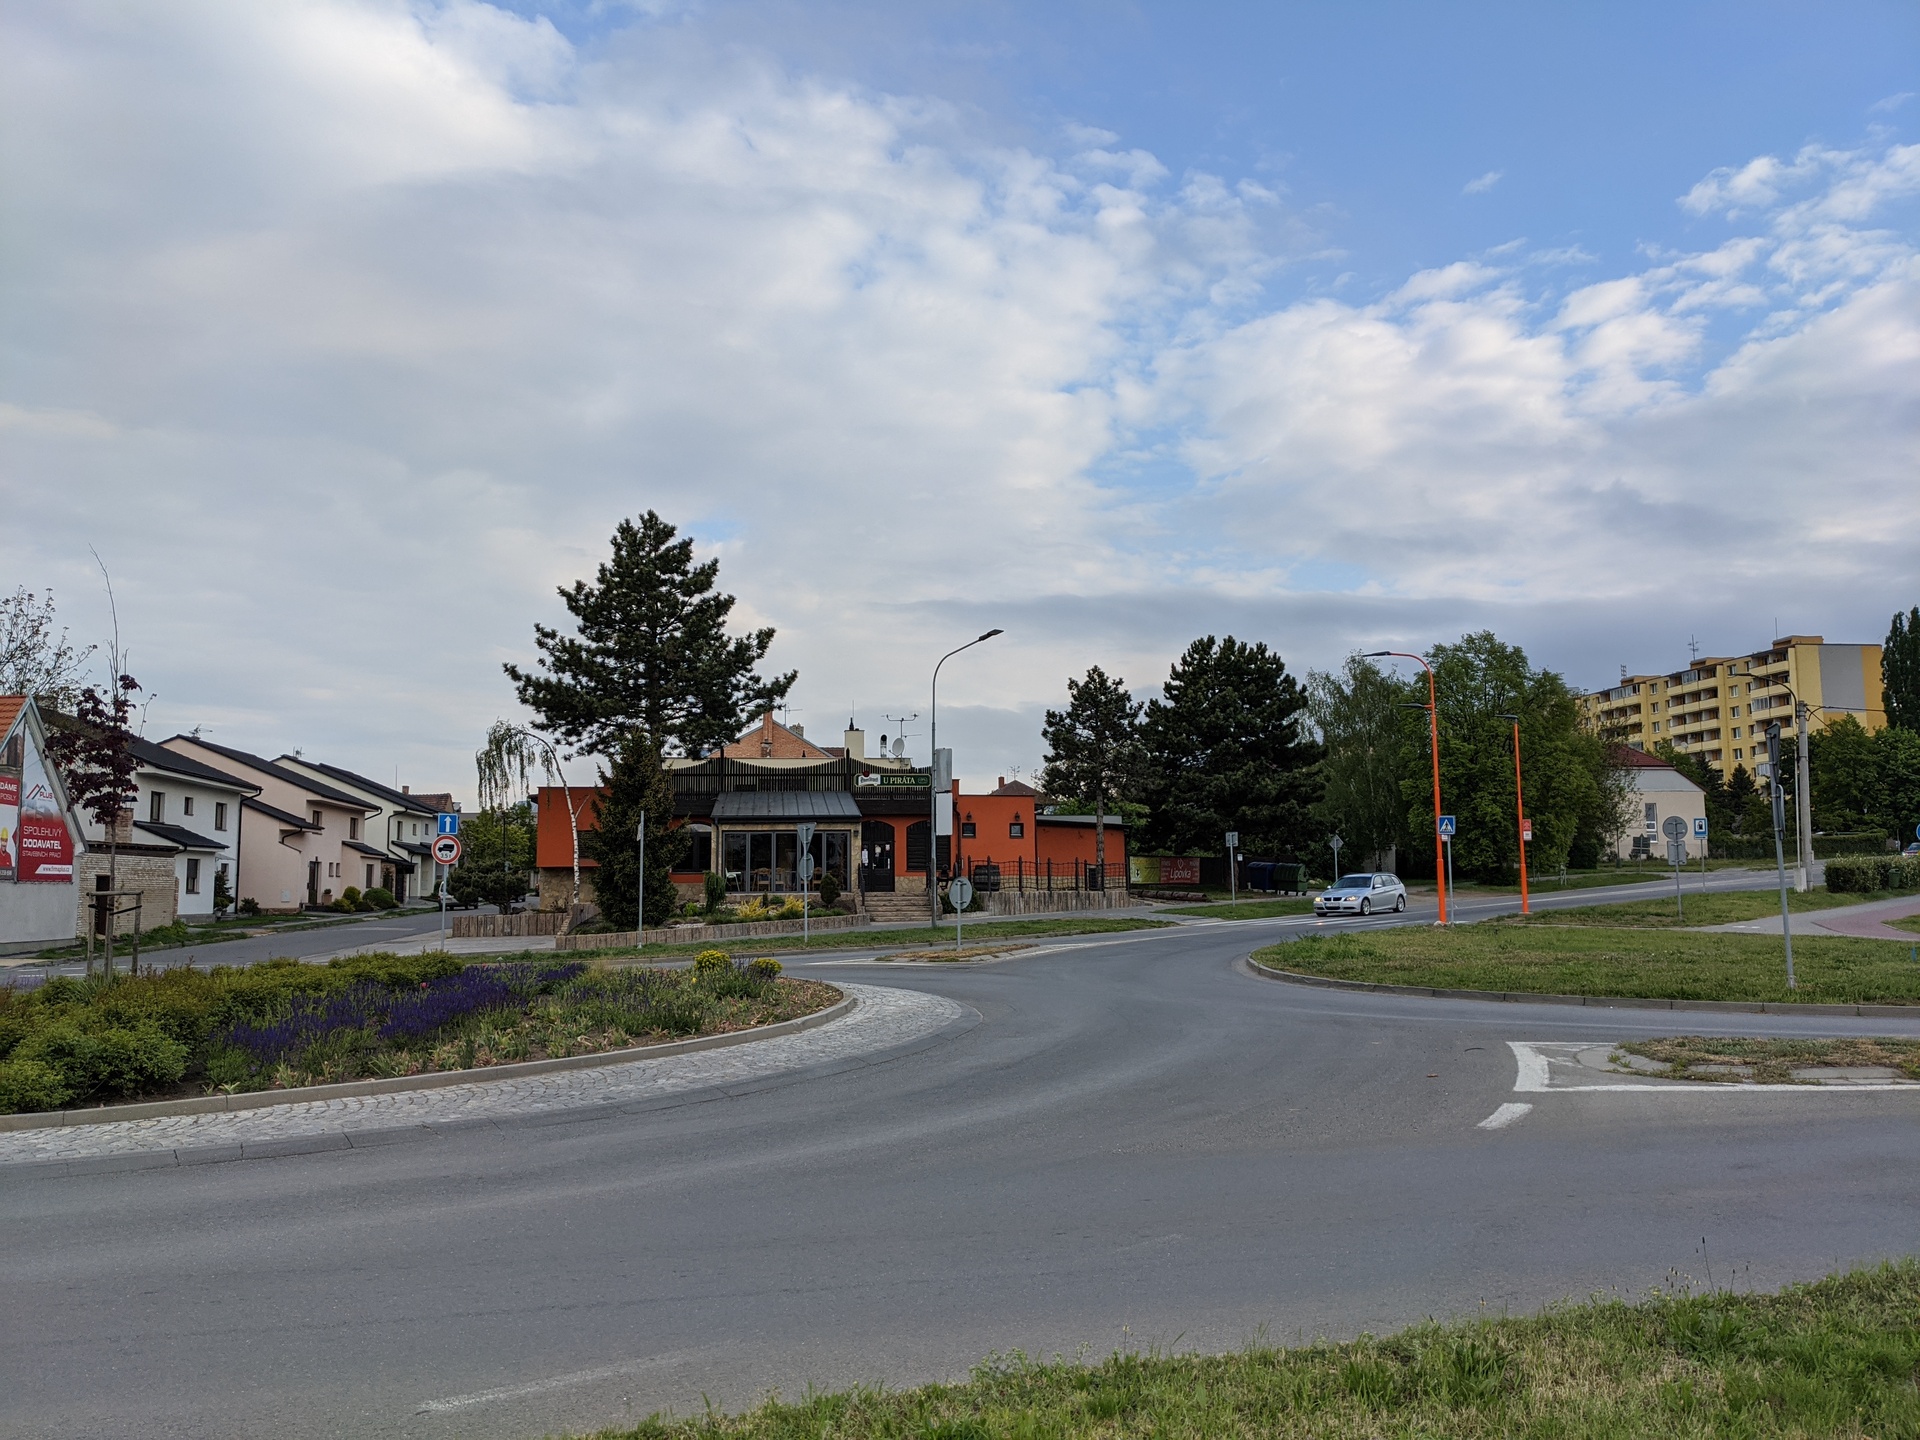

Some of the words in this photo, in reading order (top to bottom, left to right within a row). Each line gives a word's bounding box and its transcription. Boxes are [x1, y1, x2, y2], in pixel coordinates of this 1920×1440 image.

[890, 776, 916, 784] PIRÁTA
[39, 791, 53, 799] PLUS
[23, 825, 62, 837] SPOLEHLIVÝ
[23, 838, 61, 849] DODAVATEL
